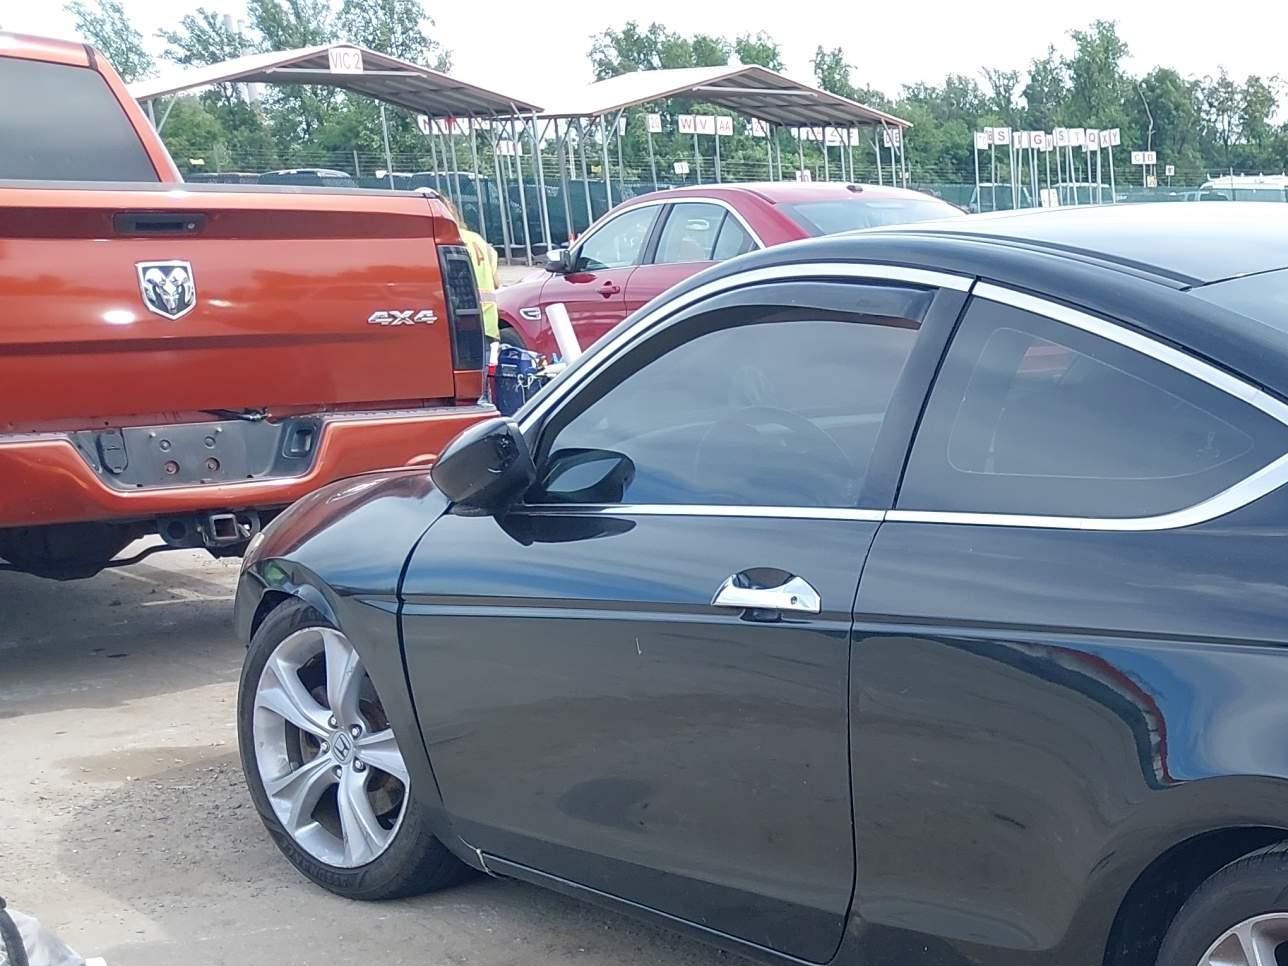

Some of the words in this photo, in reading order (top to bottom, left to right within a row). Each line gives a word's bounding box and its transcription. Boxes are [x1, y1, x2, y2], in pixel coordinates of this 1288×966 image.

[330, 52, 351, 70] VIC
[353, 52, 361, 70] 2
[997, 130, 1006, 141] S
